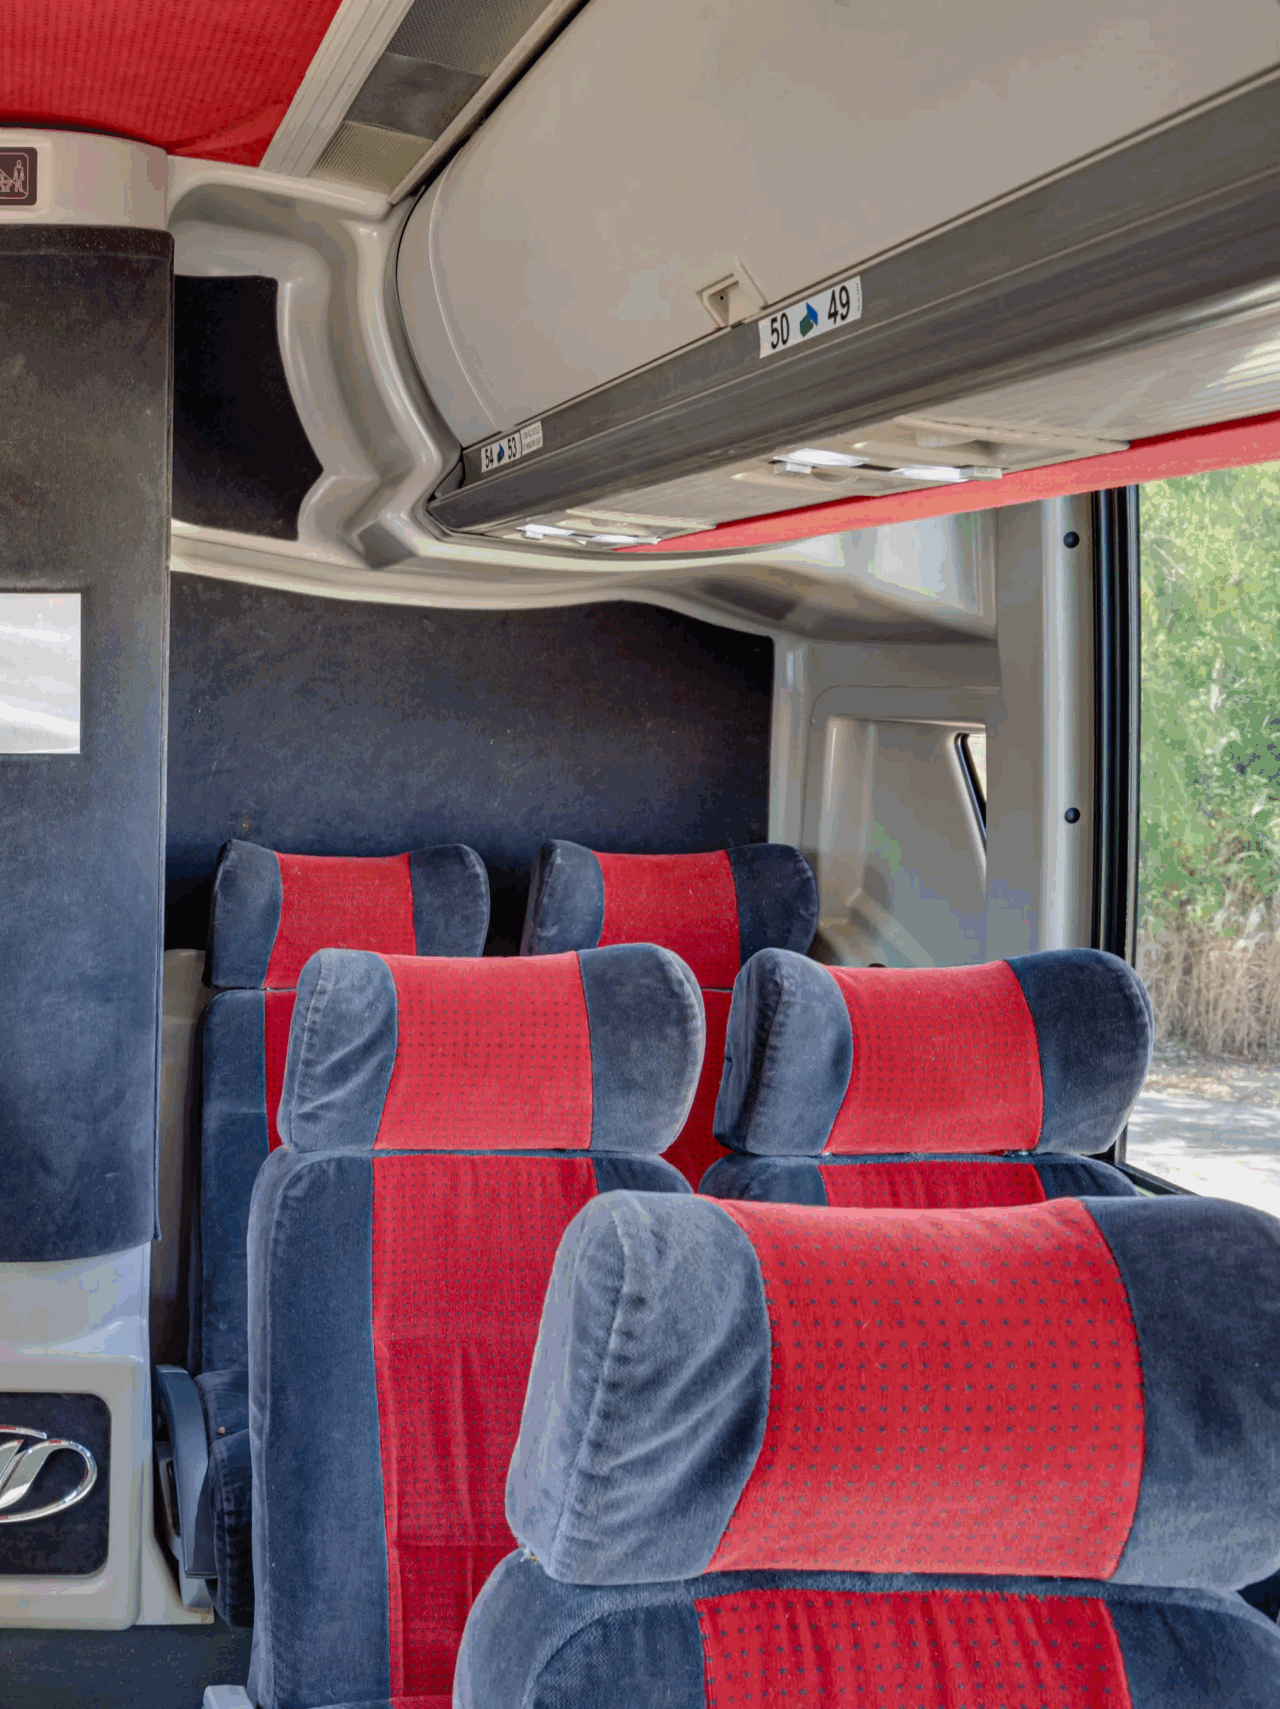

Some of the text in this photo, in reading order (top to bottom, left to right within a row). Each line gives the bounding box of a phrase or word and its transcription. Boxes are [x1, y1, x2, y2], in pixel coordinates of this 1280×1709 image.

[770, 312, 790, 350] 50
[828, 285, 850, 325] 49
[485, 446, 494, 468] 54
[507, 436, 517, 460] 53
